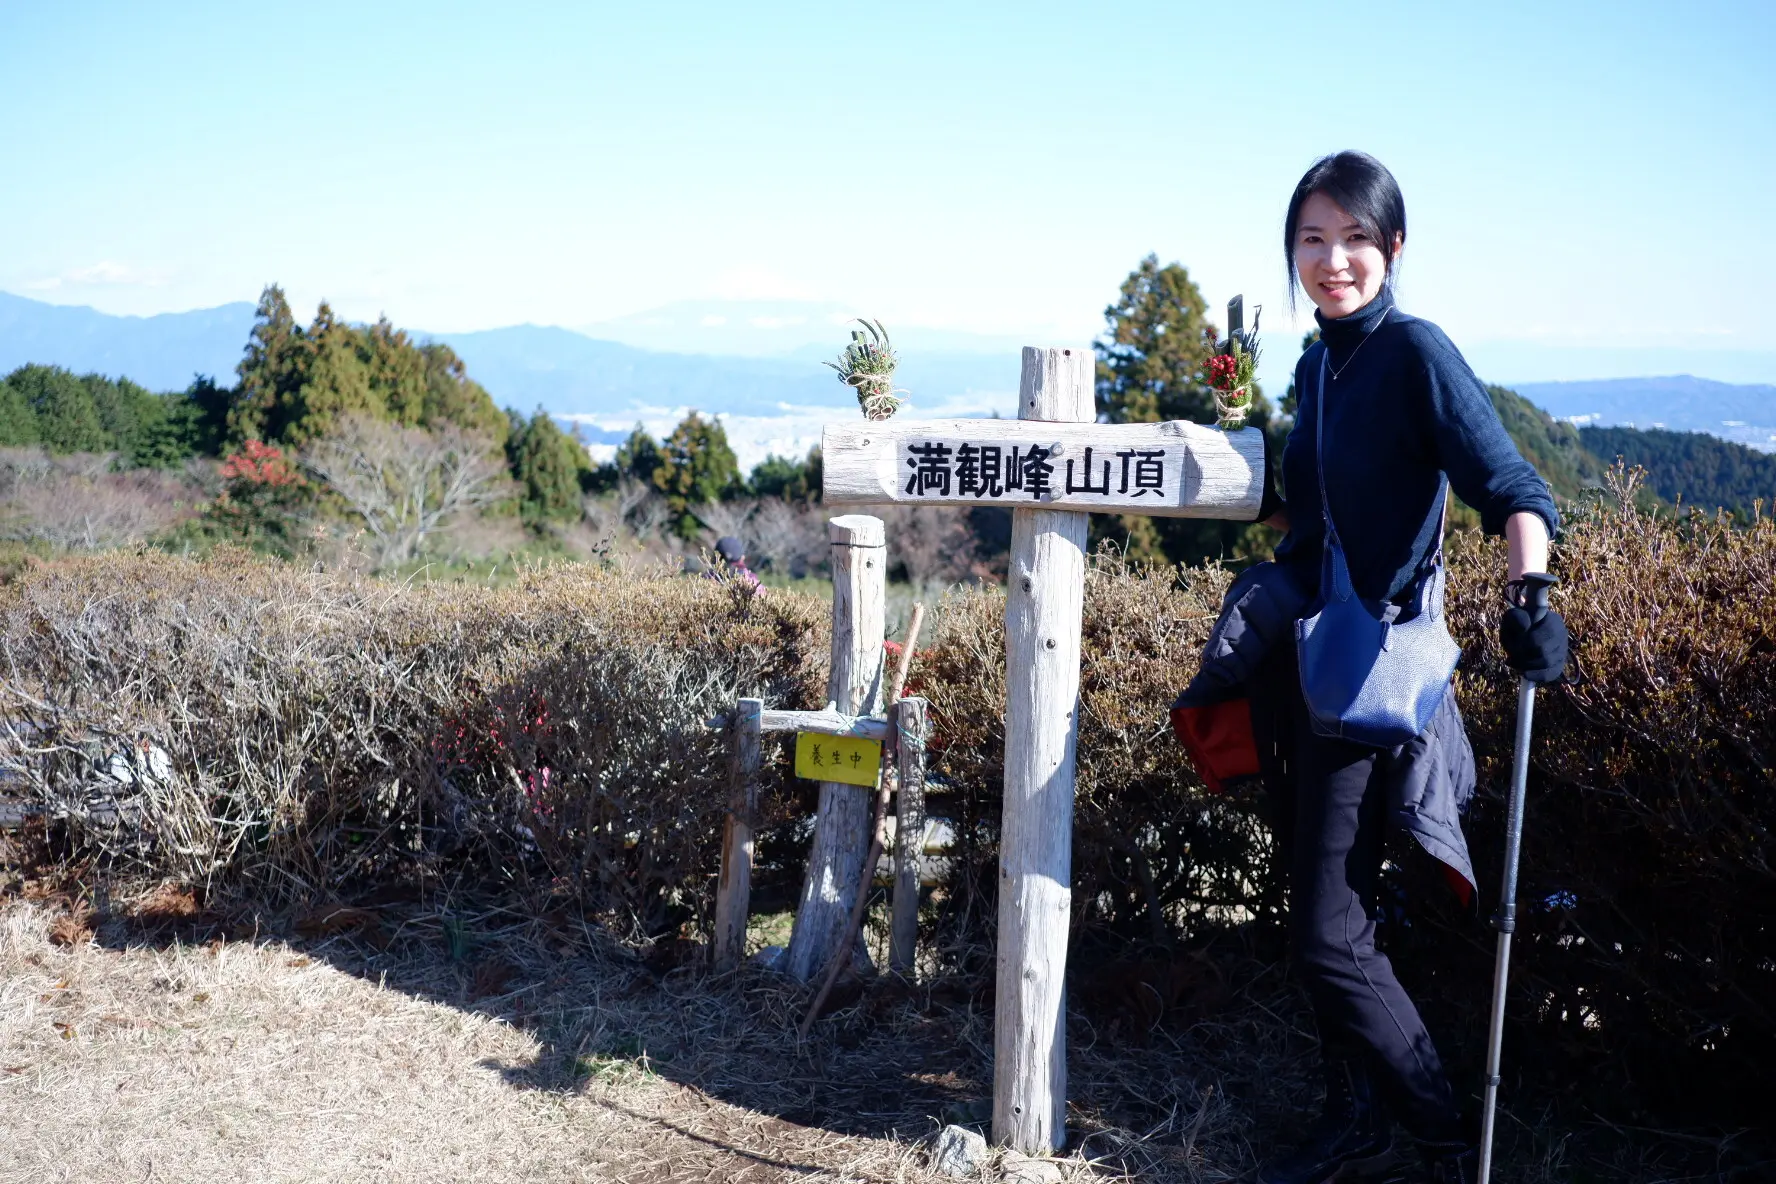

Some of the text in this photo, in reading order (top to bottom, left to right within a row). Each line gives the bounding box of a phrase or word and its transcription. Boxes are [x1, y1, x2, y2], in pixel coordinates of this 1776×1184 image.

[905, 442, 1165, 498] 満観峰山頂
[811, 743, 862, 769] 養生中
